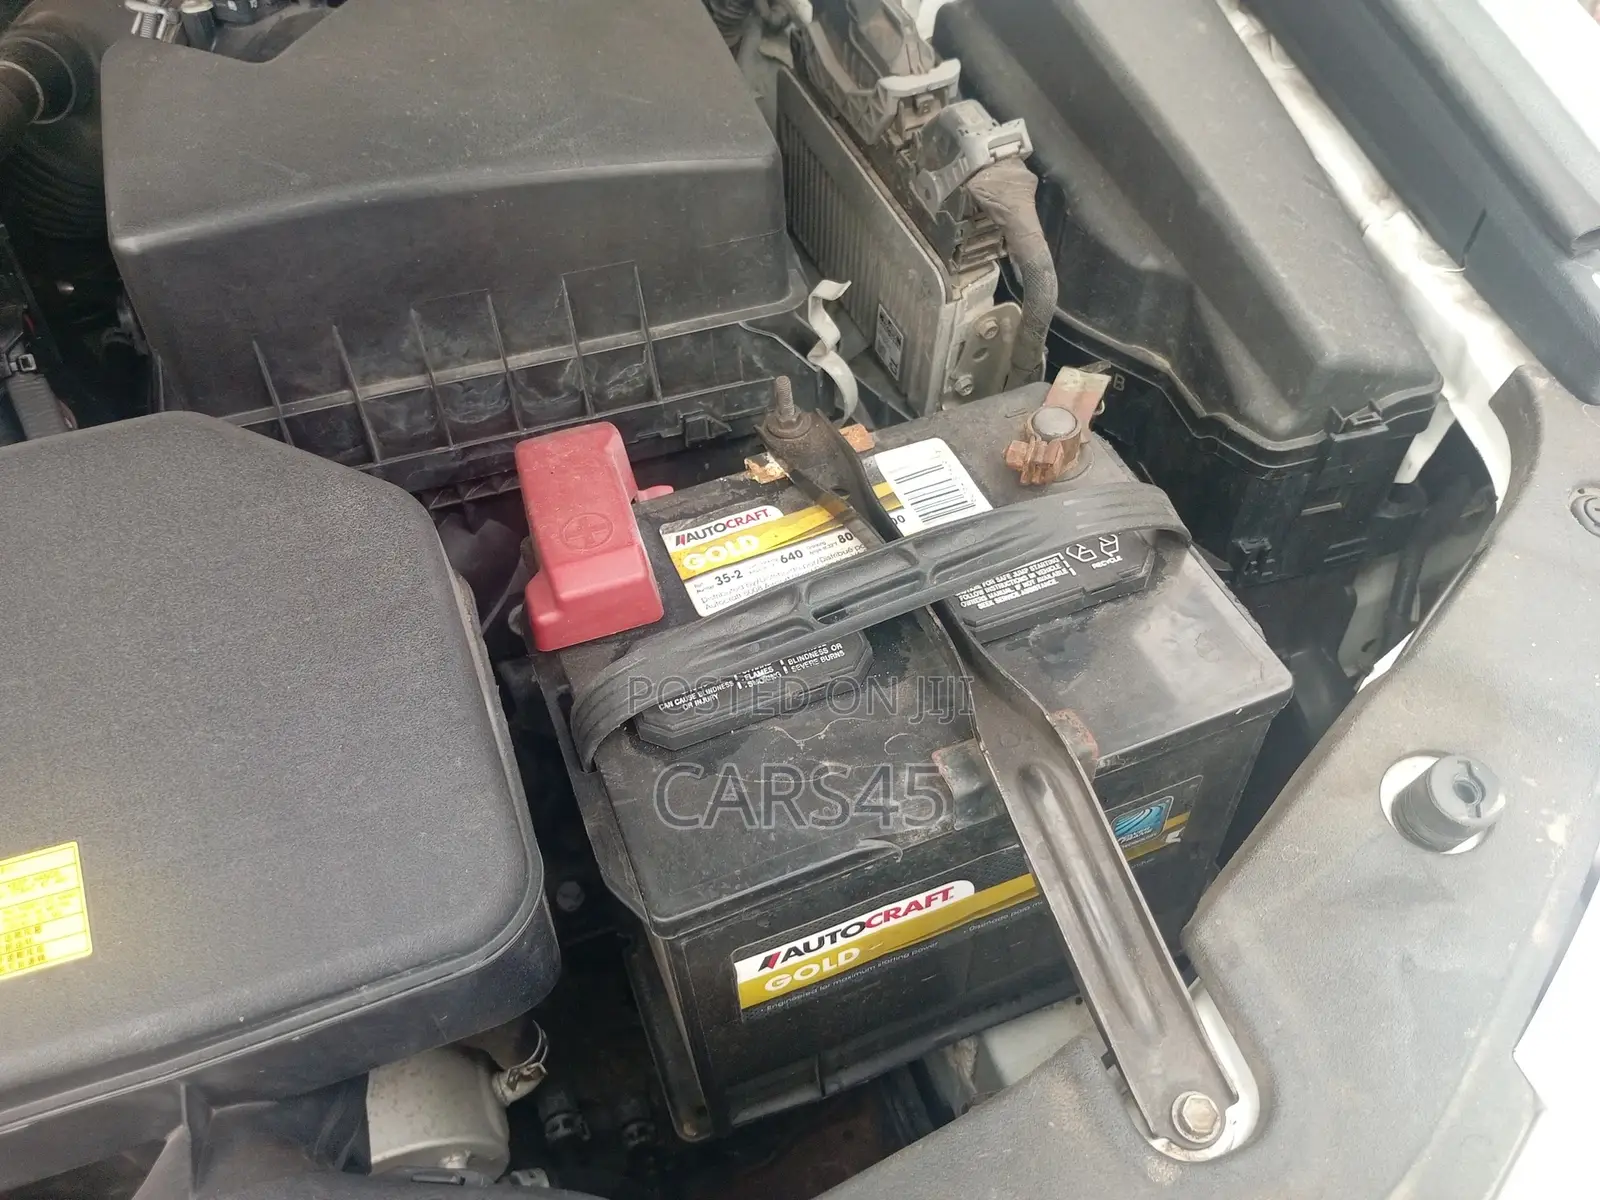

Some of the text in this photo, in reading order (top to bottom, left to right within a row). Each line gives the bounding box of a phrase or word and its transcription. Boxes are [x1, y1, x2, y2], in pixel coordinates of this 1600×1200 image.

[686, 508, 771, 544] AUTOCRAFT
[837, 532, 854, 544] 80
[682, 534, 760, 571] GOLD
[779, 549, 804, 564] 640
[714, 569, 744, 586] 35-2
[787, 647, 829, 666] BLINDNESS
[830, 642, 843, 651] OR
[790, 650, 846, 673] SEVERE BURNS
[658, 701, 674, 711] CAN
[673, 692, 697, 706] CAUSE
[697, 680, 735, 698] BLINDNESS
[682, 693, 719, 711] OR INJURY
[780, 886, 954, 964] AUTOCRAFT
[764, 947, 861, 992] GOLD
[832, 964, 878, 986] maximum
